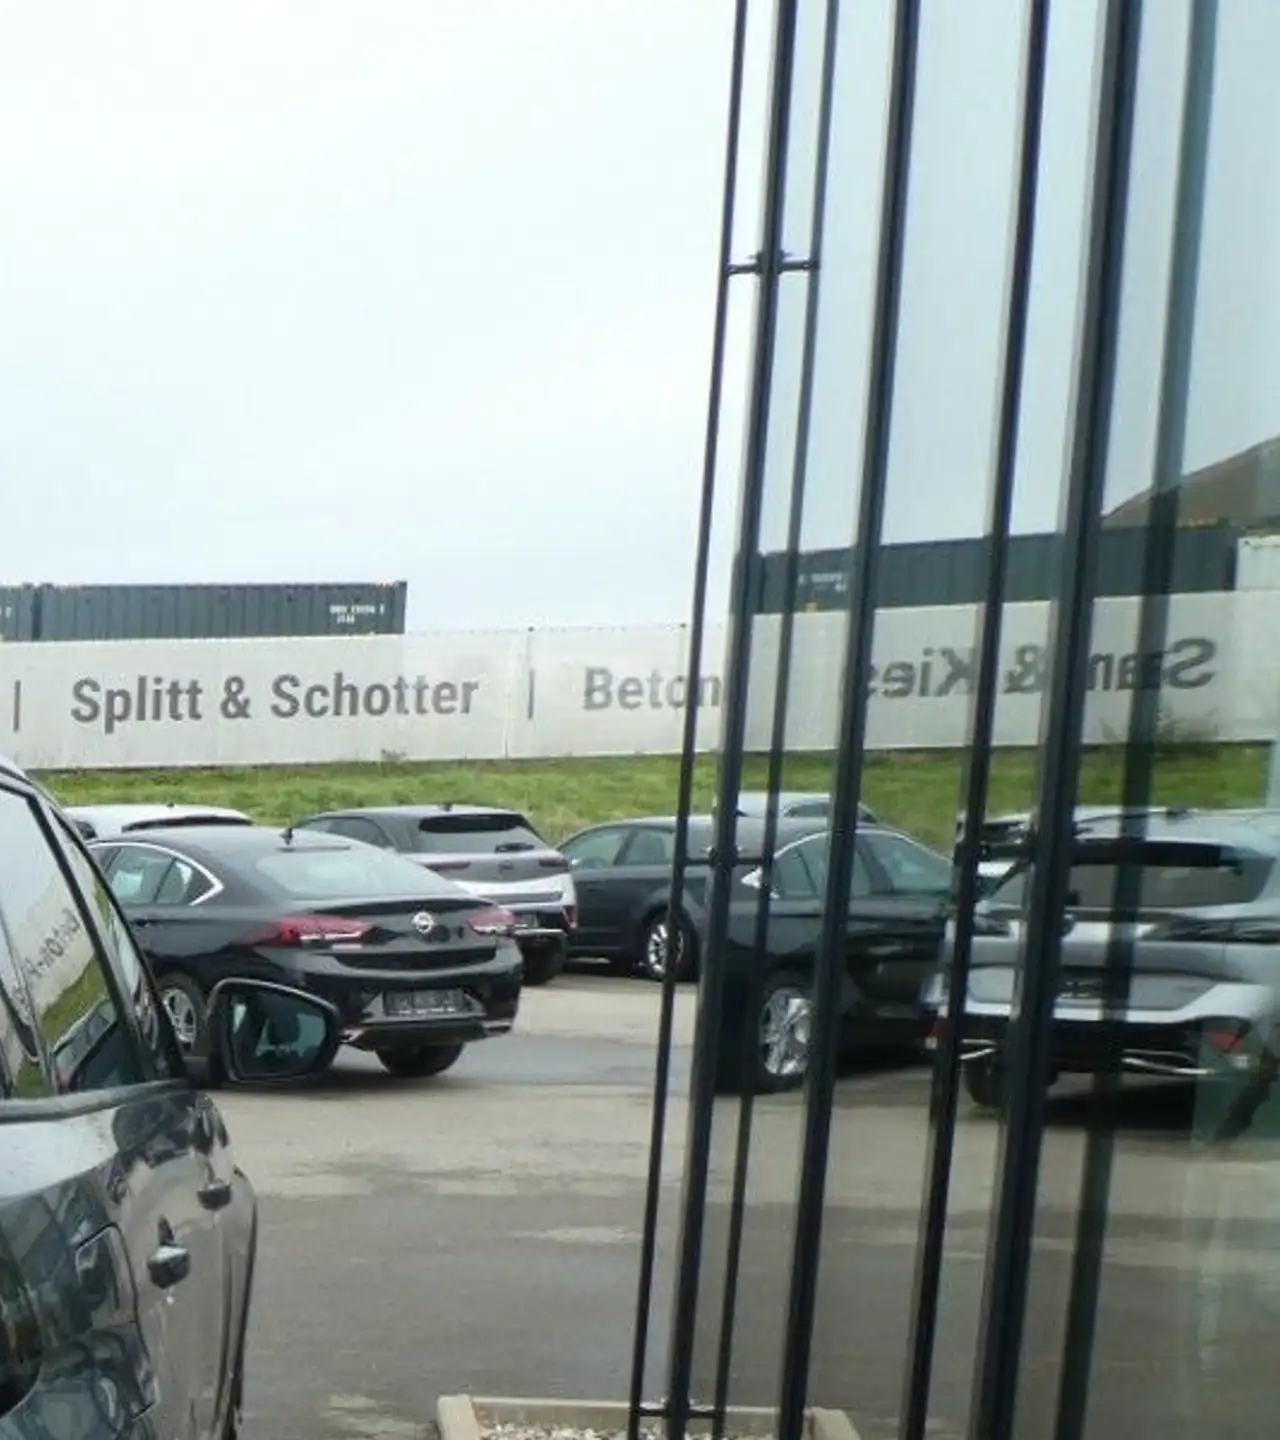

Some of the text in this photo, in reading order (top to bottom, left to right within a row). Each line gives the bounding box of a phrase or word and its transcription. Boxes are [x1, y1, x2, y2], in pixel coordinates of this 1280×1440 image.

[70, 674, 203, 734] Splitt
[219, 675, 251, 720] &
[269, 671, 480, 719] Schotter
